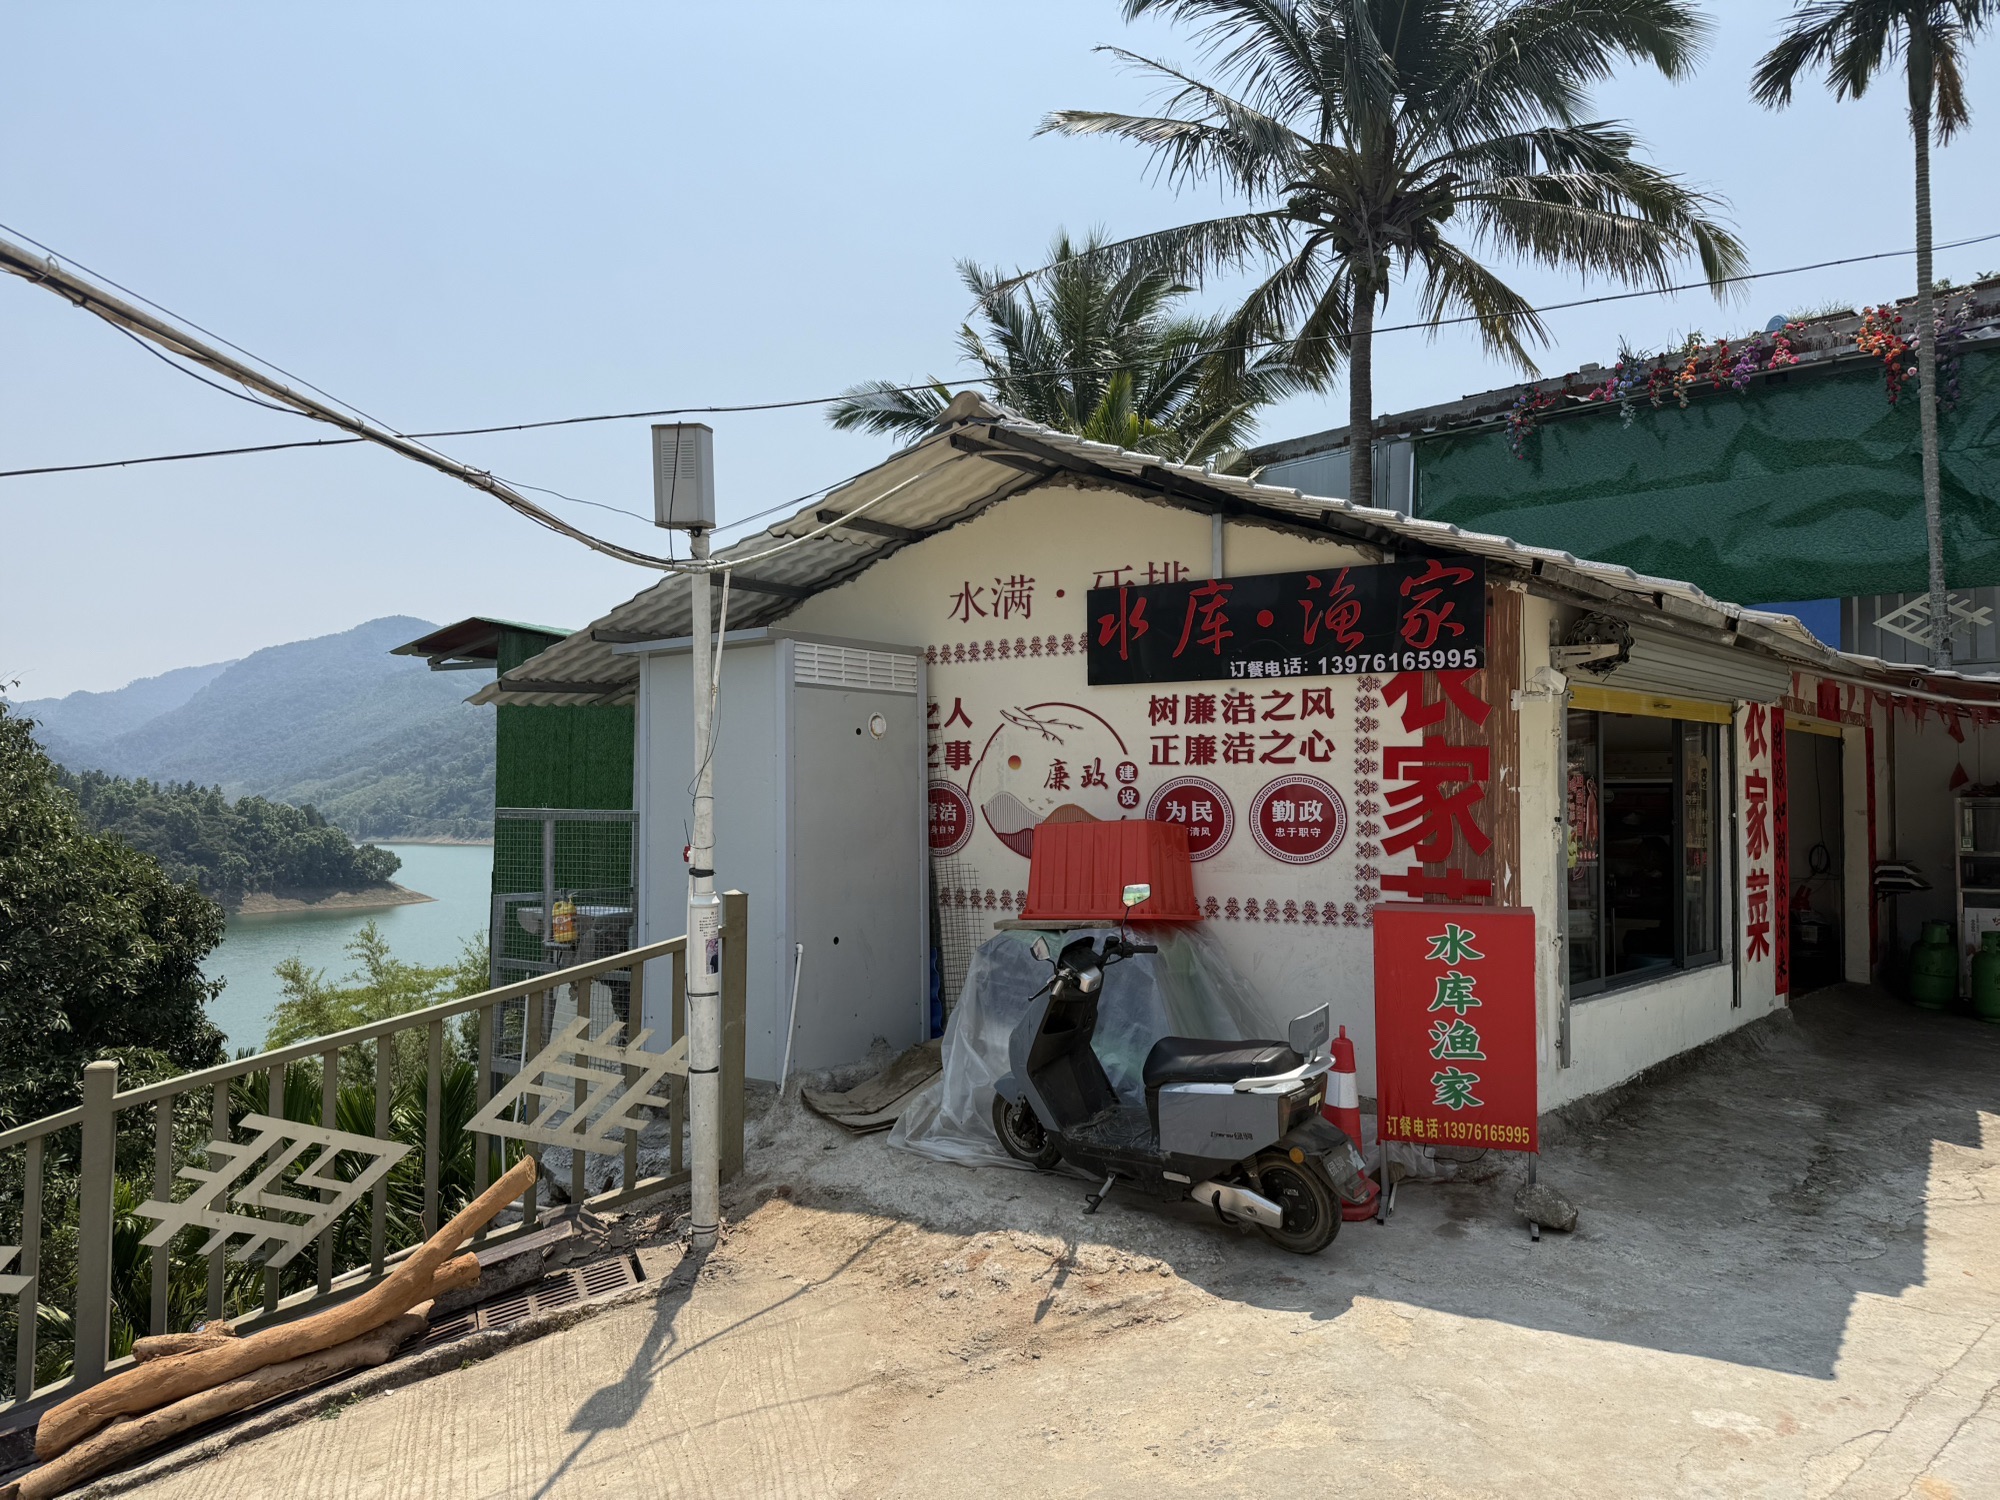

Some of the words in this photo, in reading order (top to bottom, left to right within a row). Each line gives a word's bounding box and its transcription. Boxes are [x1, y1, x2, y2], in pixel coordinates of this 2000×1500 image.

[1097, 559, 1475, 661] 水库·渔家
[1148, 687, 1335, 726] 树廉洁之风
[1149, 729, 1336, 766] 正廉洁之心
[1044, 757, 1109, 791] 廉政
[1118, 764, 1139, 806] 建设
[1165, 800, 1213, 823] 为民
[1272, 800, 1324, 823] 勤政
[1275, 827, 1321, 838] 忠于职守
[1425, 923, 1487, 1110] 水库渔家
